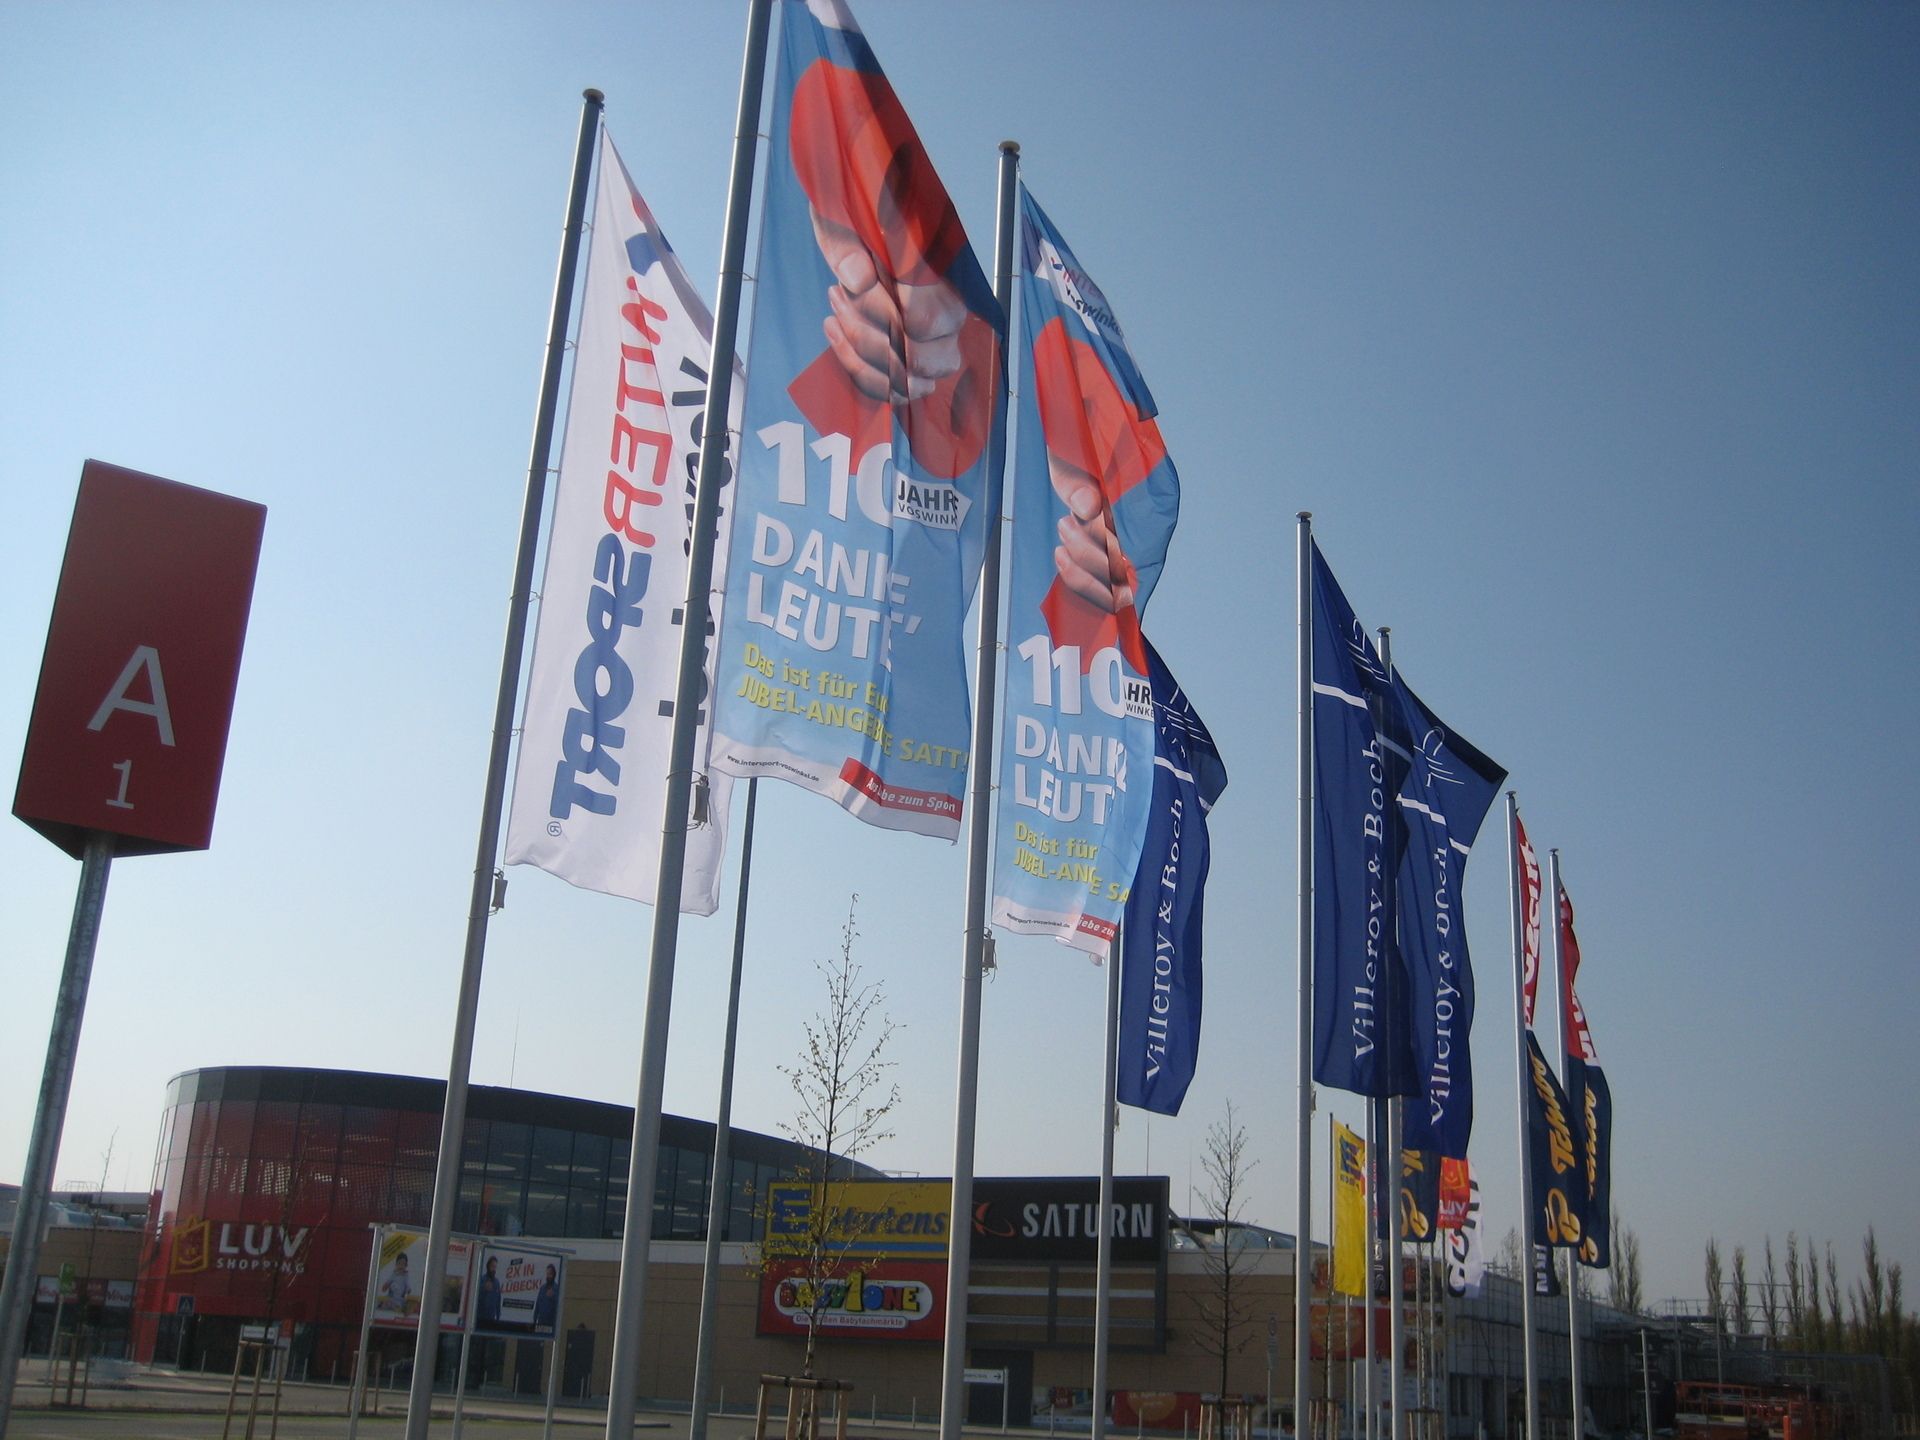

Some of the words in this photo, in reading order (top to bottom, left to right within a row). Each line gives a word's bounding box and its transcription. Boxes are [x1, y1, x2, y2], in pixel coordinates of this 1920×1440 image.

[756, 421, 893, 529] 110
[898, 502, 958, 526] VOSWINK
[744, 643, 775, 678] Das
[783, 658, 811, 690] ist
[817, 671, 858, 700] für
[1017, 634, 1127, 720] 110
[87, 645, 176, 747] A
[900, 738, 970, 776] SATT!
[106, 759, 135, 810] 1
[1362, 737, 1384, 845] Boch
[1014, 821, 1038, 849] Das
[1039, 832, 1060, 857] ist
[1067, 837, 1099, 861] für
[1161, 797, 1183, 893] Boch
[1367, 852, 1382, 881] &
[1158, 899, 1173, 925] &
[1146, 931, 1176, 1081] Villeroy
[219, 1223, 309, 1258] LUV
[1022, 1203, 1154, 1238] SATURN
[216, 1257, 305, 1274] SHOPPING
